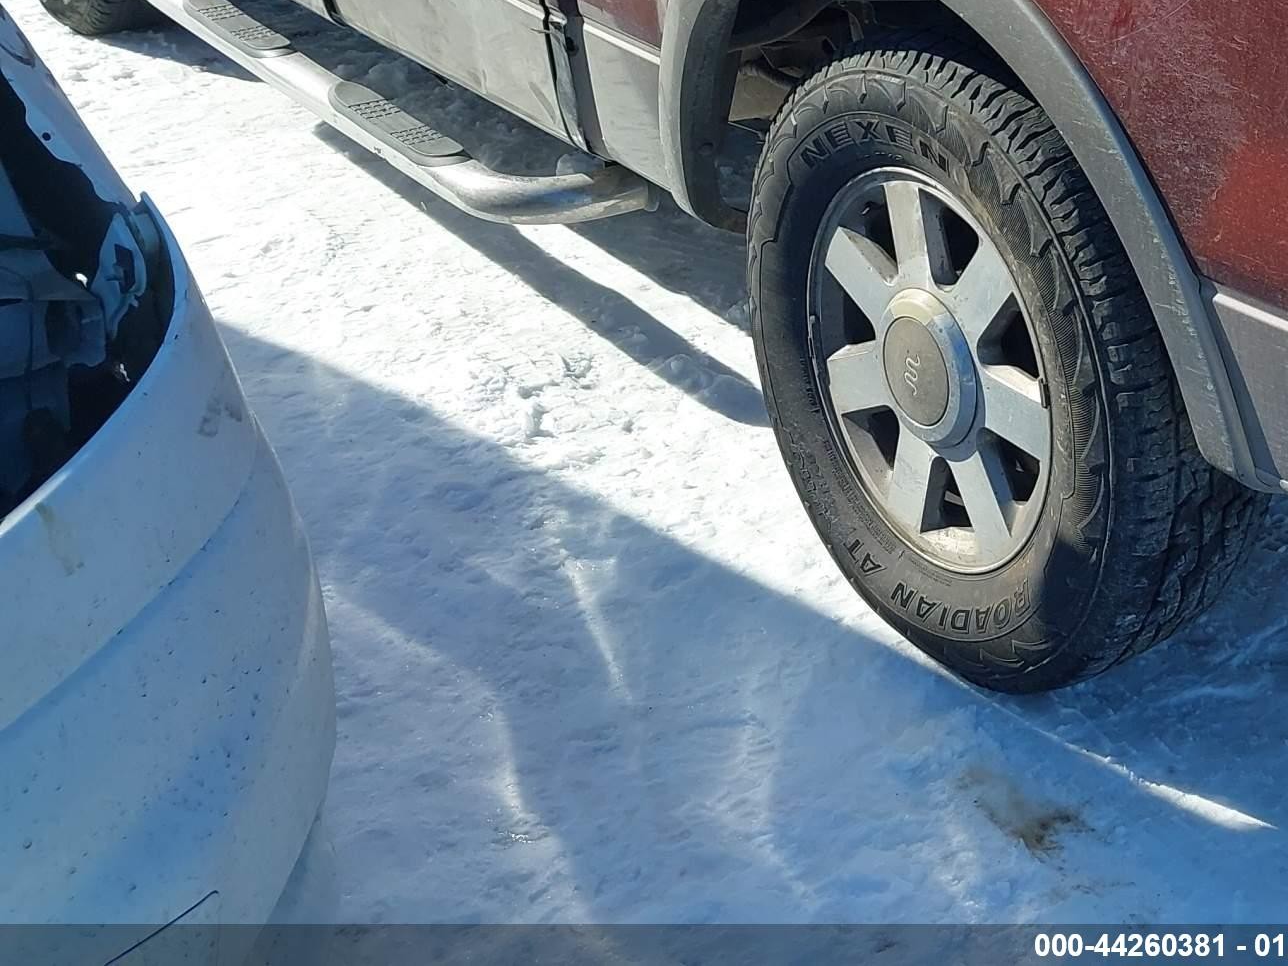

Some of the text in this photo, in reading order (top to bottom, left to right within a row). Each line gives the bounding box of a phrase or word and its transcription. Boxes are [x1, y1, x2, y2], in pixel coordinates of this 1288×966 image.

[800, 119, 951, 176] NEXEN
[848, 537, 887, 577] AT
[890, 579, 1030, 635] ROADIAN
